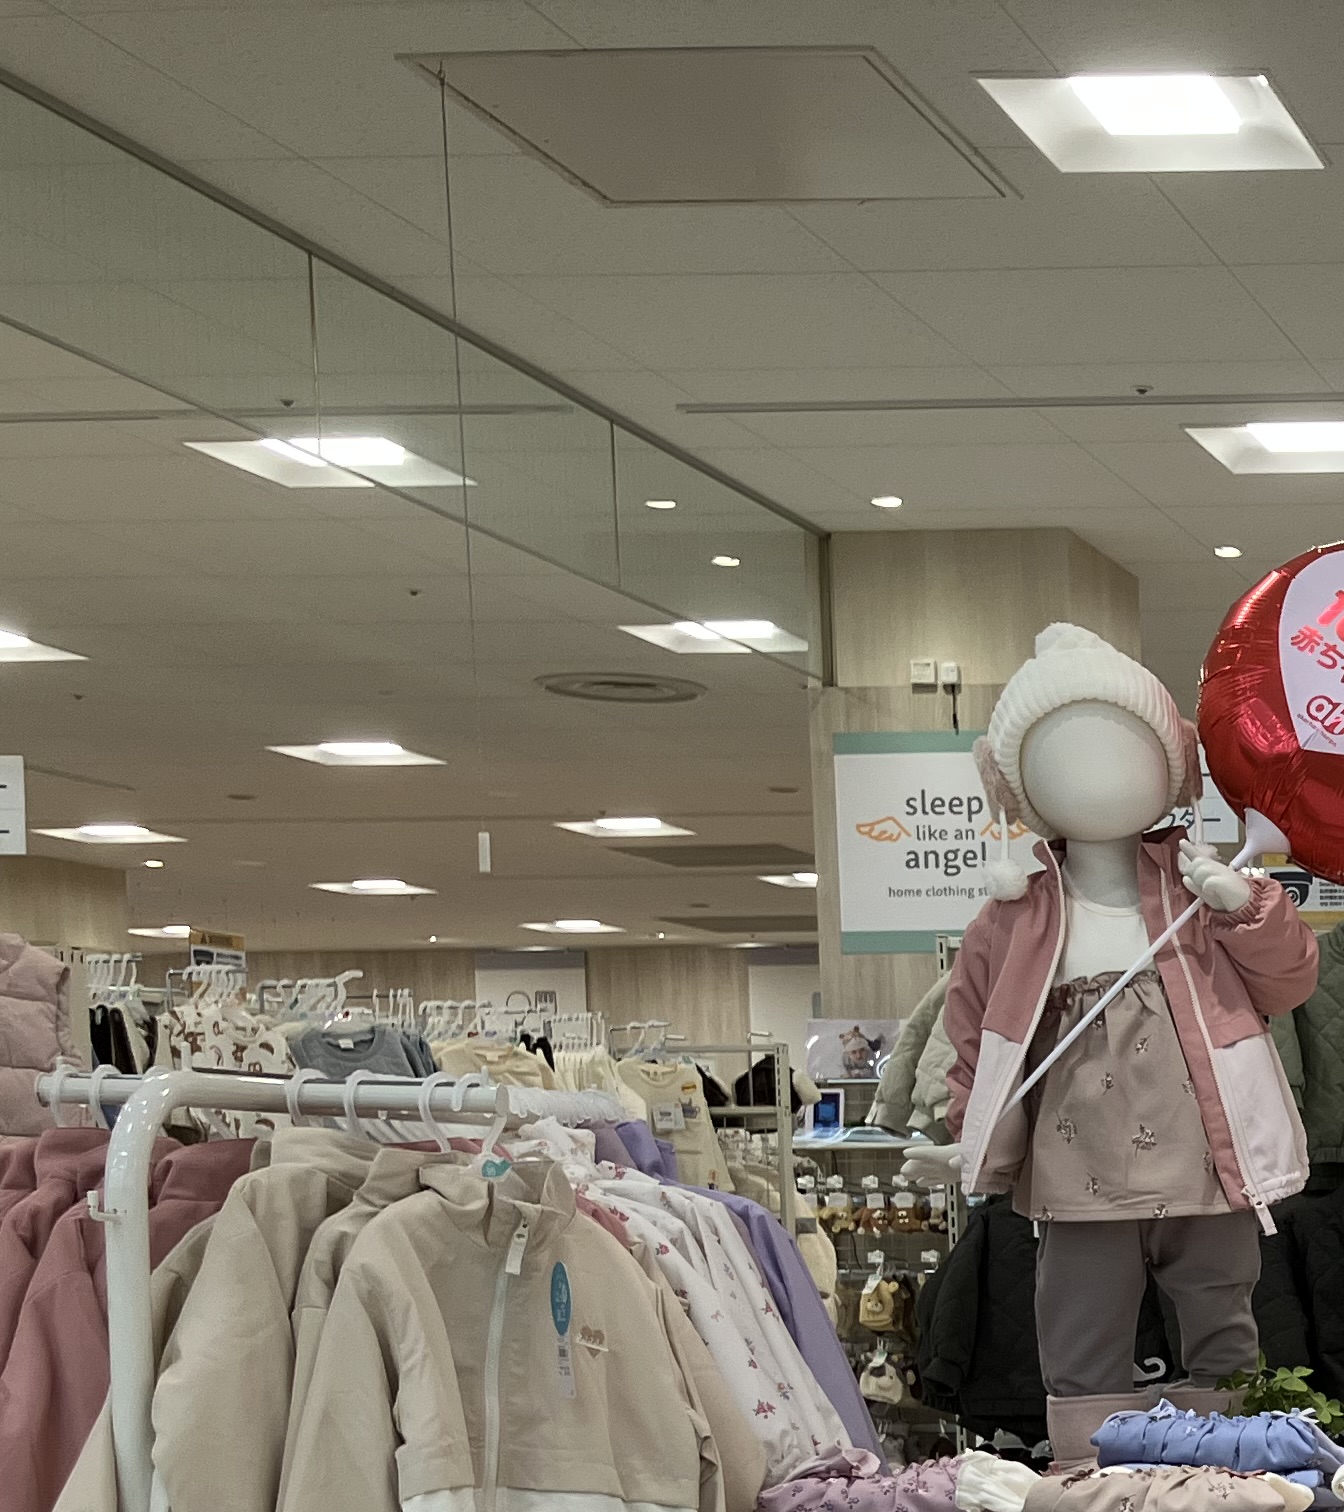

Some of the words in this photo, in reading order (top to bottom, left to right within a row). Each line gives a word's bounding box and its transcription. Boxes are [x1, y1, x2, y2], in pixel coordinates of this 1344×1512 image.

[905, 789, 984, 823] sleep
[916, 825, 948, 841] like
[954, 828, 975, 841] an
[905, 841, 987, 876] angel
[888, 887, 922, 898] home
[926, 886, 975, 899] clothing
